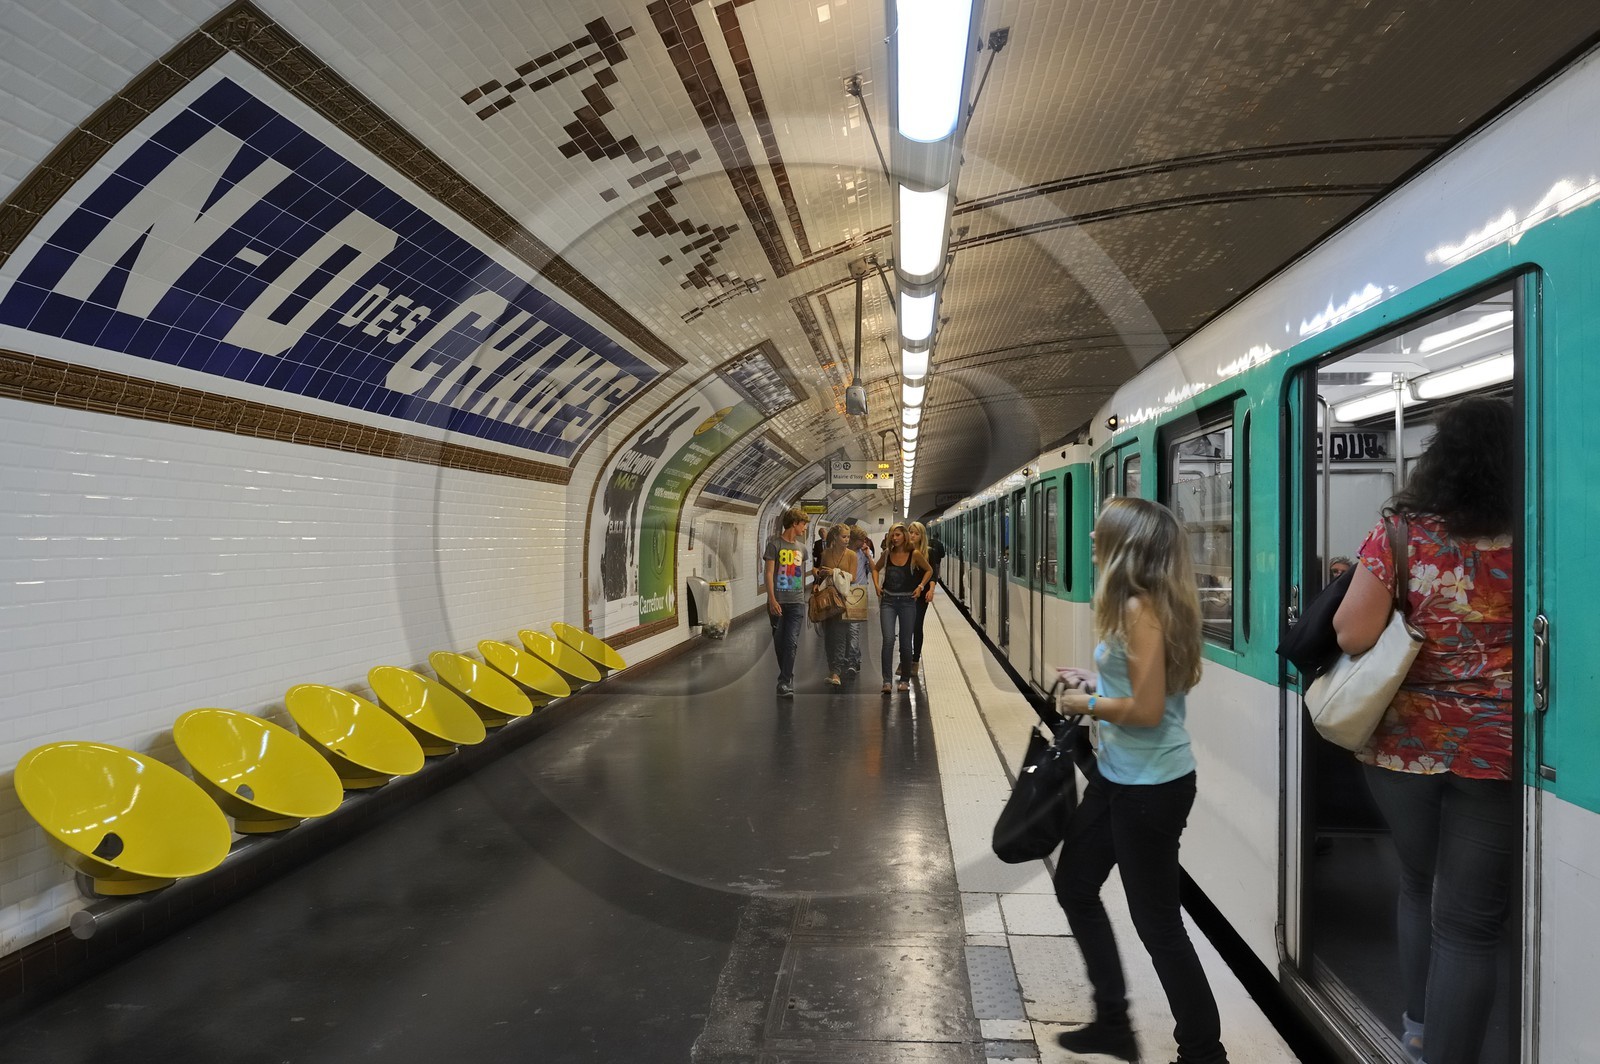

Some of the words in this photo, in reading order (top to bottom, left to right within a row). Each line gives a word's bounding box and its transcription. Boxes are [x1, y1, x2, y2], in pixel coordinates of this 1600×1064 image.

[339, 284, 432, 344] DES
[385, 290, 639, 442] CHAMPS
[639, 592, 665, 615] Carrefour
